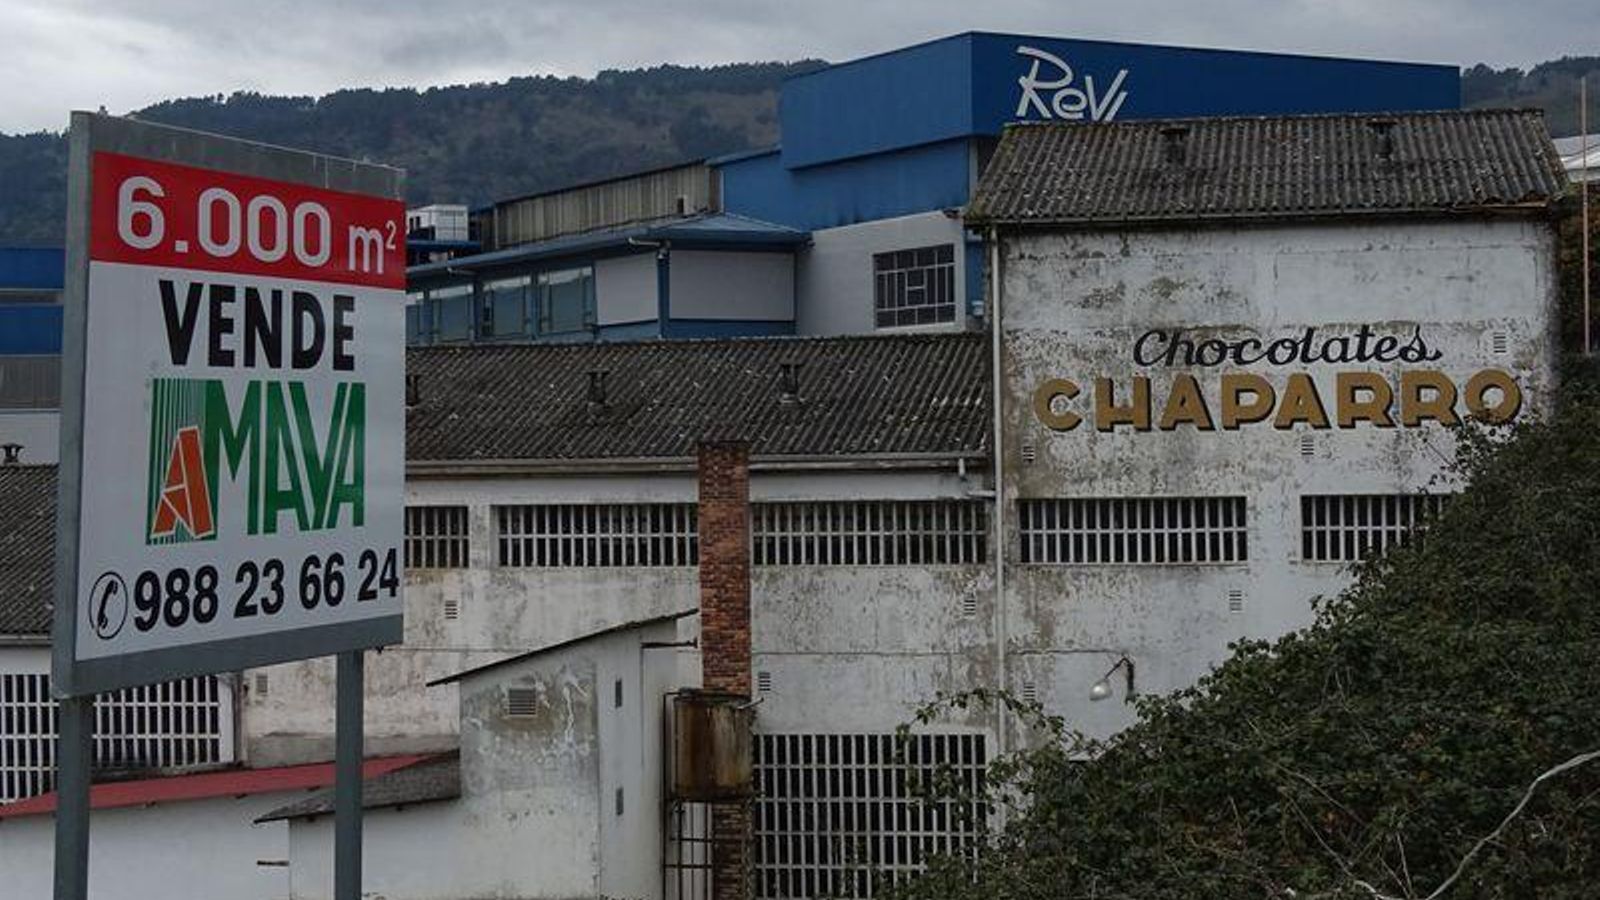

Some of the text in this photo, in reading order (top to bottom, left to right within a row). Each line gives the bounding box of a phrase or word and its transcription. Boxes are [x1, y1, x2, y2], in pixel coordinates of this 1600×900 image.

[117, 176, 331, 268] 6.000
[158, 279, 355, 371] VENDE
[1133, 324, 1442, 367] Chocolates
[1034, 368, 1523, 431] CHAPARRO
[134, 548, 399, 632] 988 23 66 24
